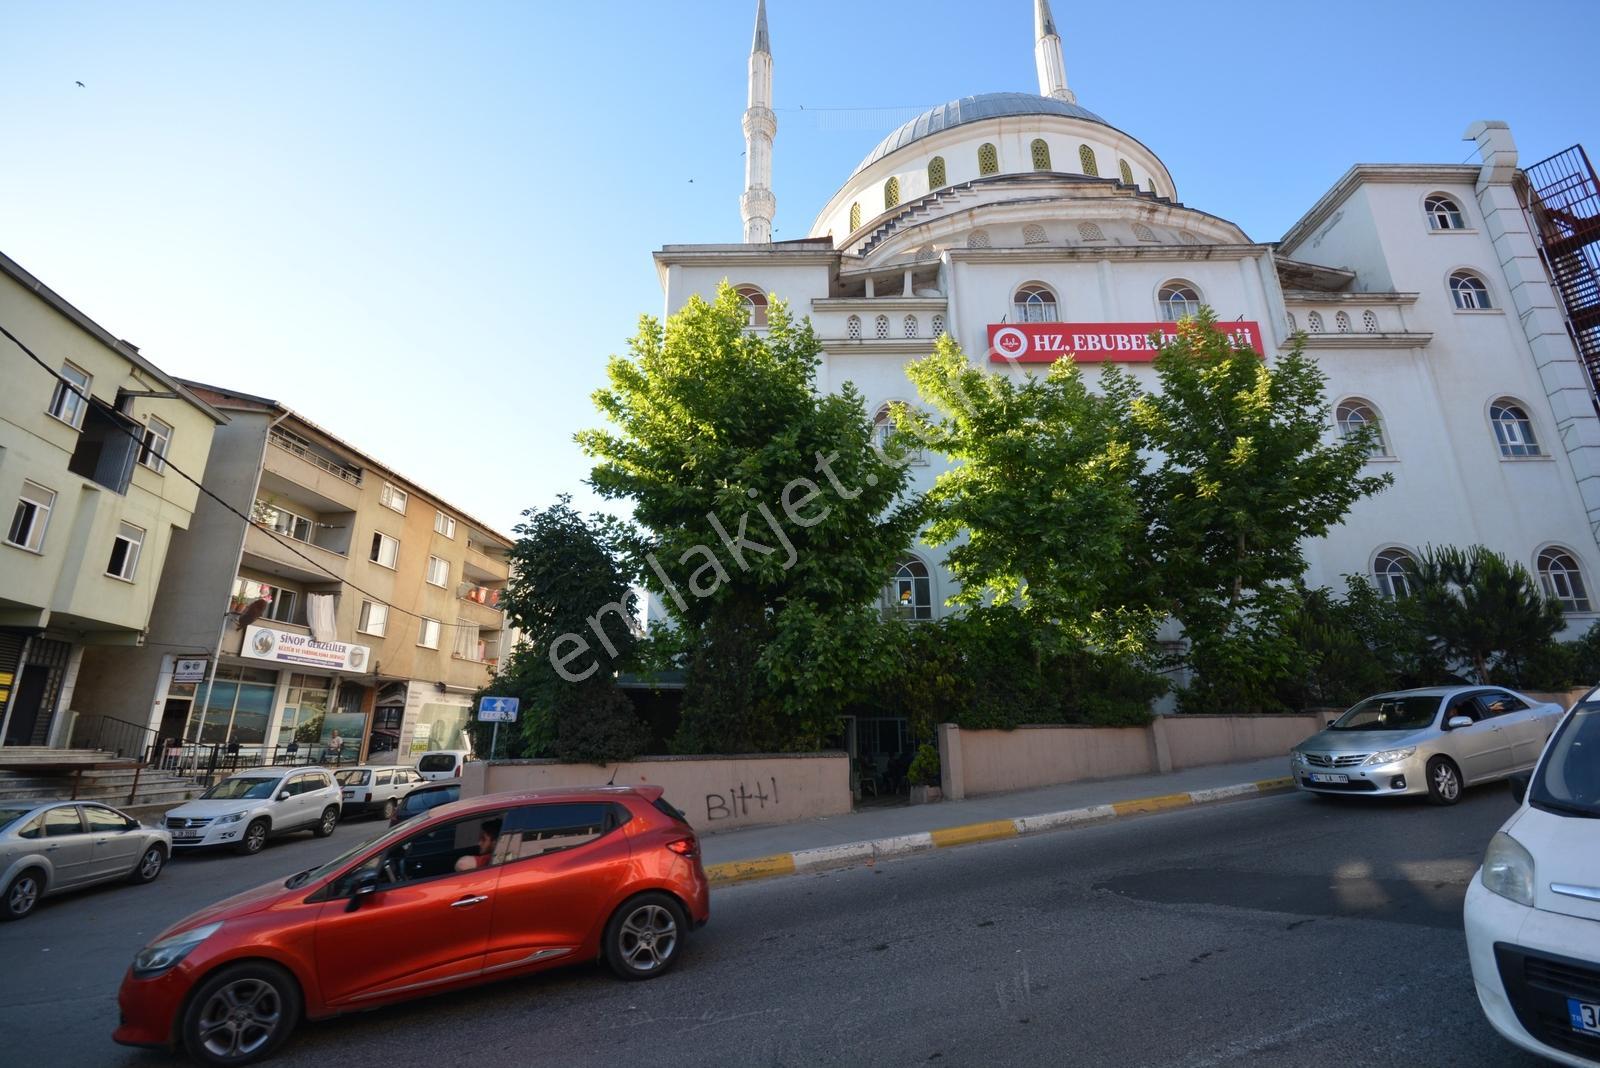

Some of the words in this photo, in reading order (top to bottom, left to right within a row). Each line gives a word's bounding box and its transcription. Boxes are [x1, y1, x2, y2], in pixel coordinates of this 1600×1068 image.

[1033, 334, 1070, 351] HZ.
[280, 633, 306, 646] SİNOP
[1582, 1005, 1600, 1028] 3
